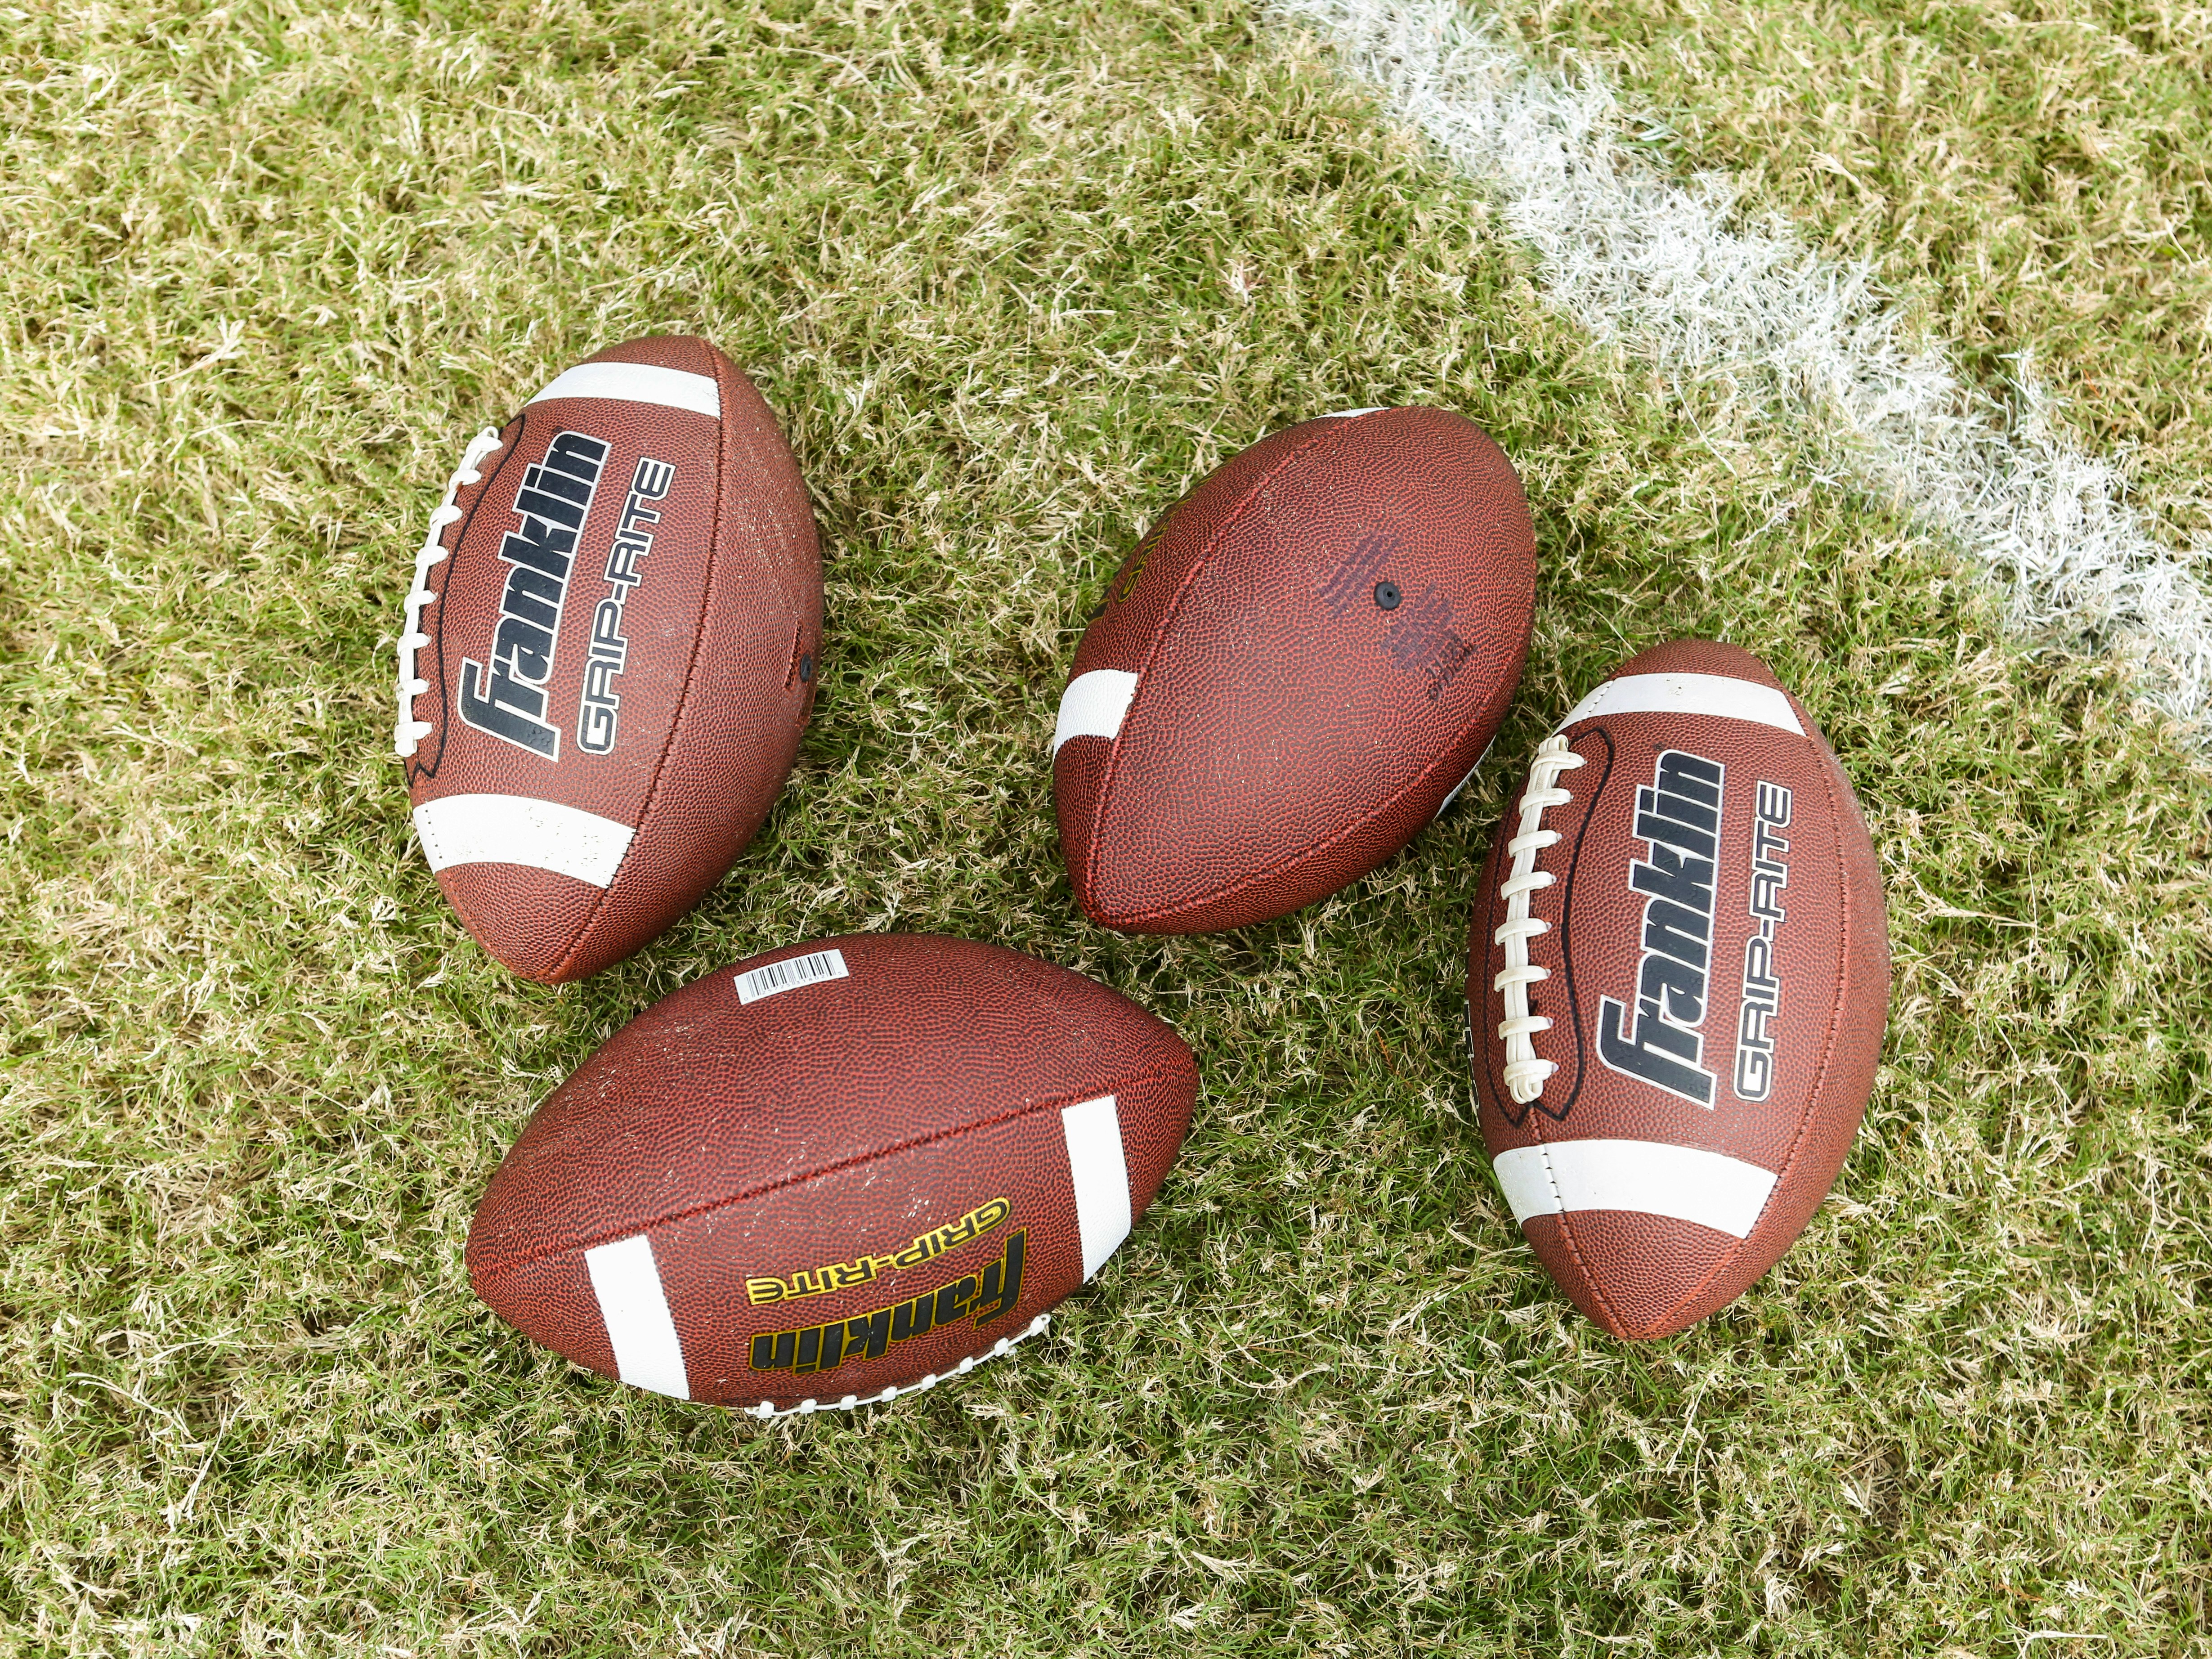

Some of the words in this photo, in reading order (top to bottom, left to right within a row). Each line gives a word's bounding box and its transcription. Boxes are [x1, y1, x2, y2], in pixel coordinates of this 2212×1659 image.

[577, 457, 676, 755] GRIP-RITE
[1390, 628, 1413, 654] MADE
[1416, 597, 1439, 622] CHINA
[1391, 631, 1426, 670] FABRIQUE
[1429, 596, 1452, 621] CHINE
[1402, 643, 1428, 672] HECHO
[1433, 610, 1455, 635] CHINA
[1733, 780, 1792, 1102] GRIP-RITE
[746, 1197, 1011, 1306] GRIP-RITE
